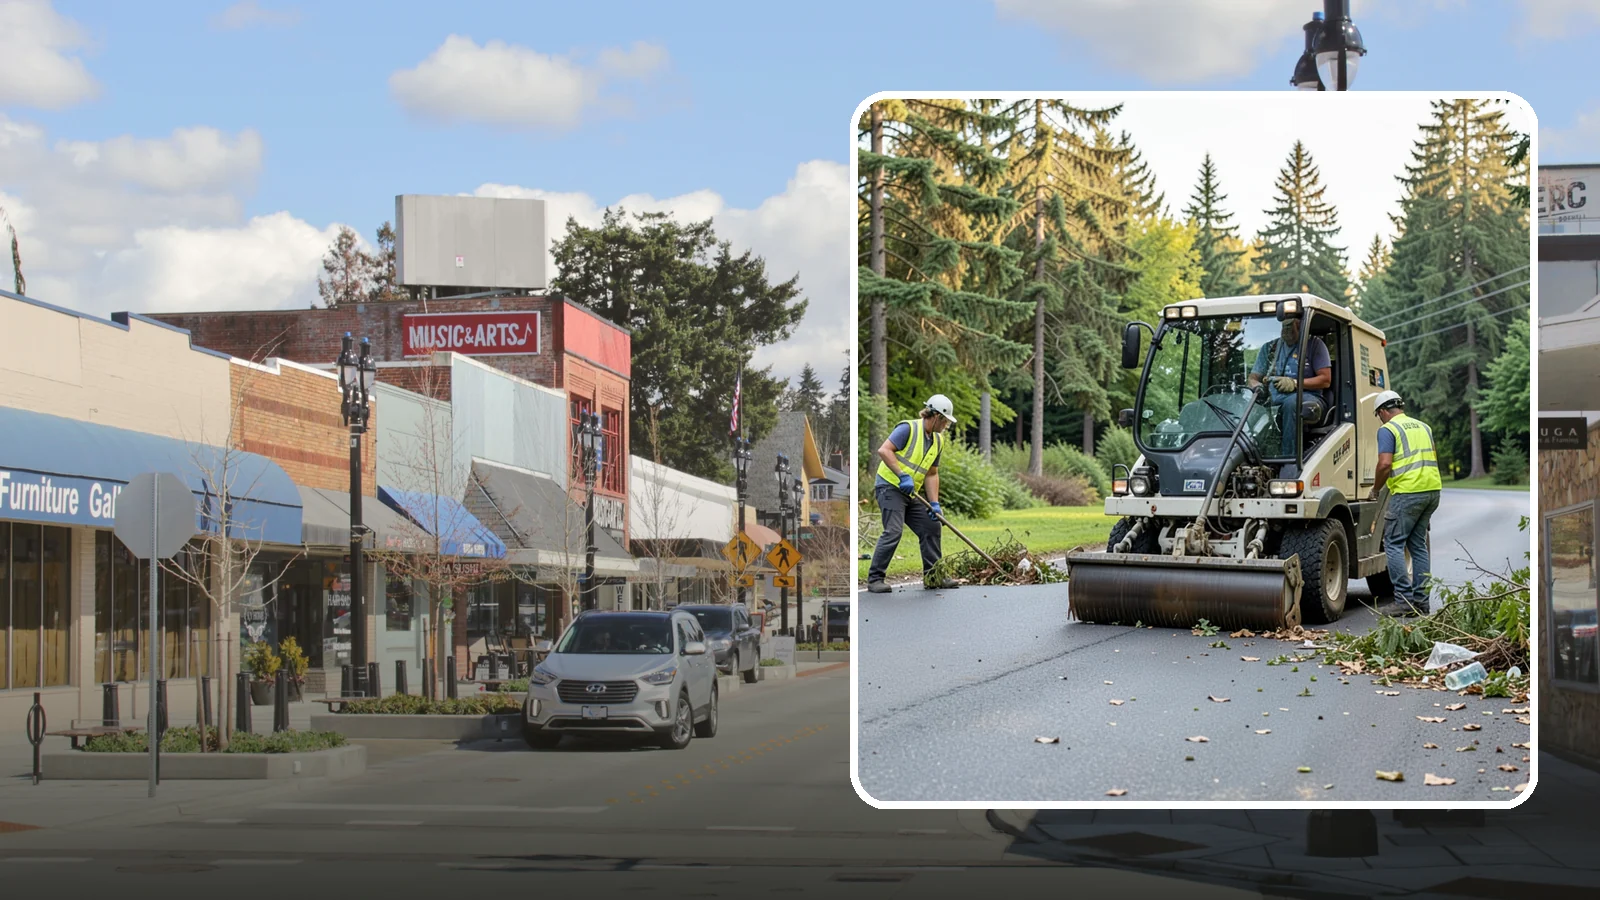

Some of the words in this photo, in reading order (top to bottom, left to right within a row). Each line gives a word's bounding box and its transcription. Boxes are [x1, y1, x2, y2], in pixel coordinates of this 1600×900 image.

[409, 323, 519, 349] MUSIC&ARTS
[1540, 427, 1577, 437] UGA
[0, 471, 79, 515] Furniture
[89, 482, 121, 519] Gal
[453, 563, 479, 574] SUSHI
